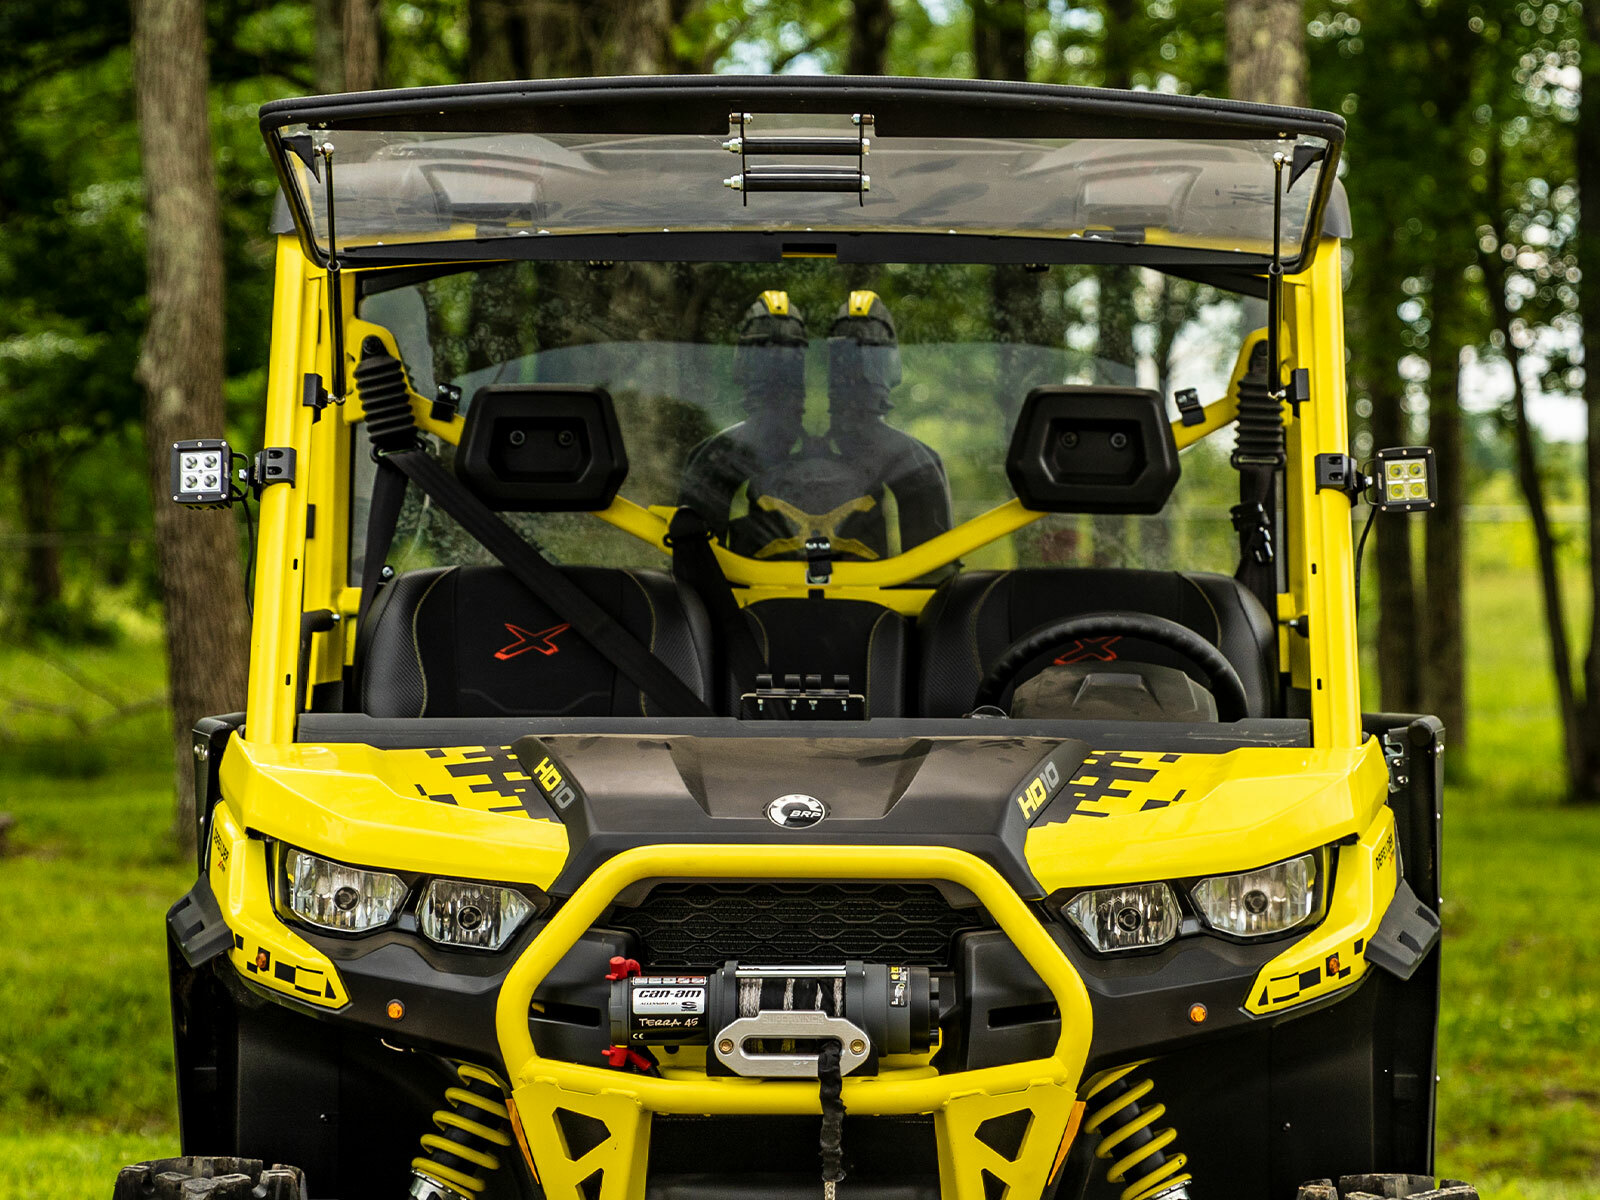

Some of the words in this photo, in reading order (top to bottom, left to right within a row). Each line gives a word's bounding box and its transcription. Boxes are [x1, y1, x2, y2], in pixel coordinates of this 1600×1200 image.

[533, 757, 576, 809] HD10
[1017, 761, 1060, 820] HD10
[790, 809, 821, 818] BRP
